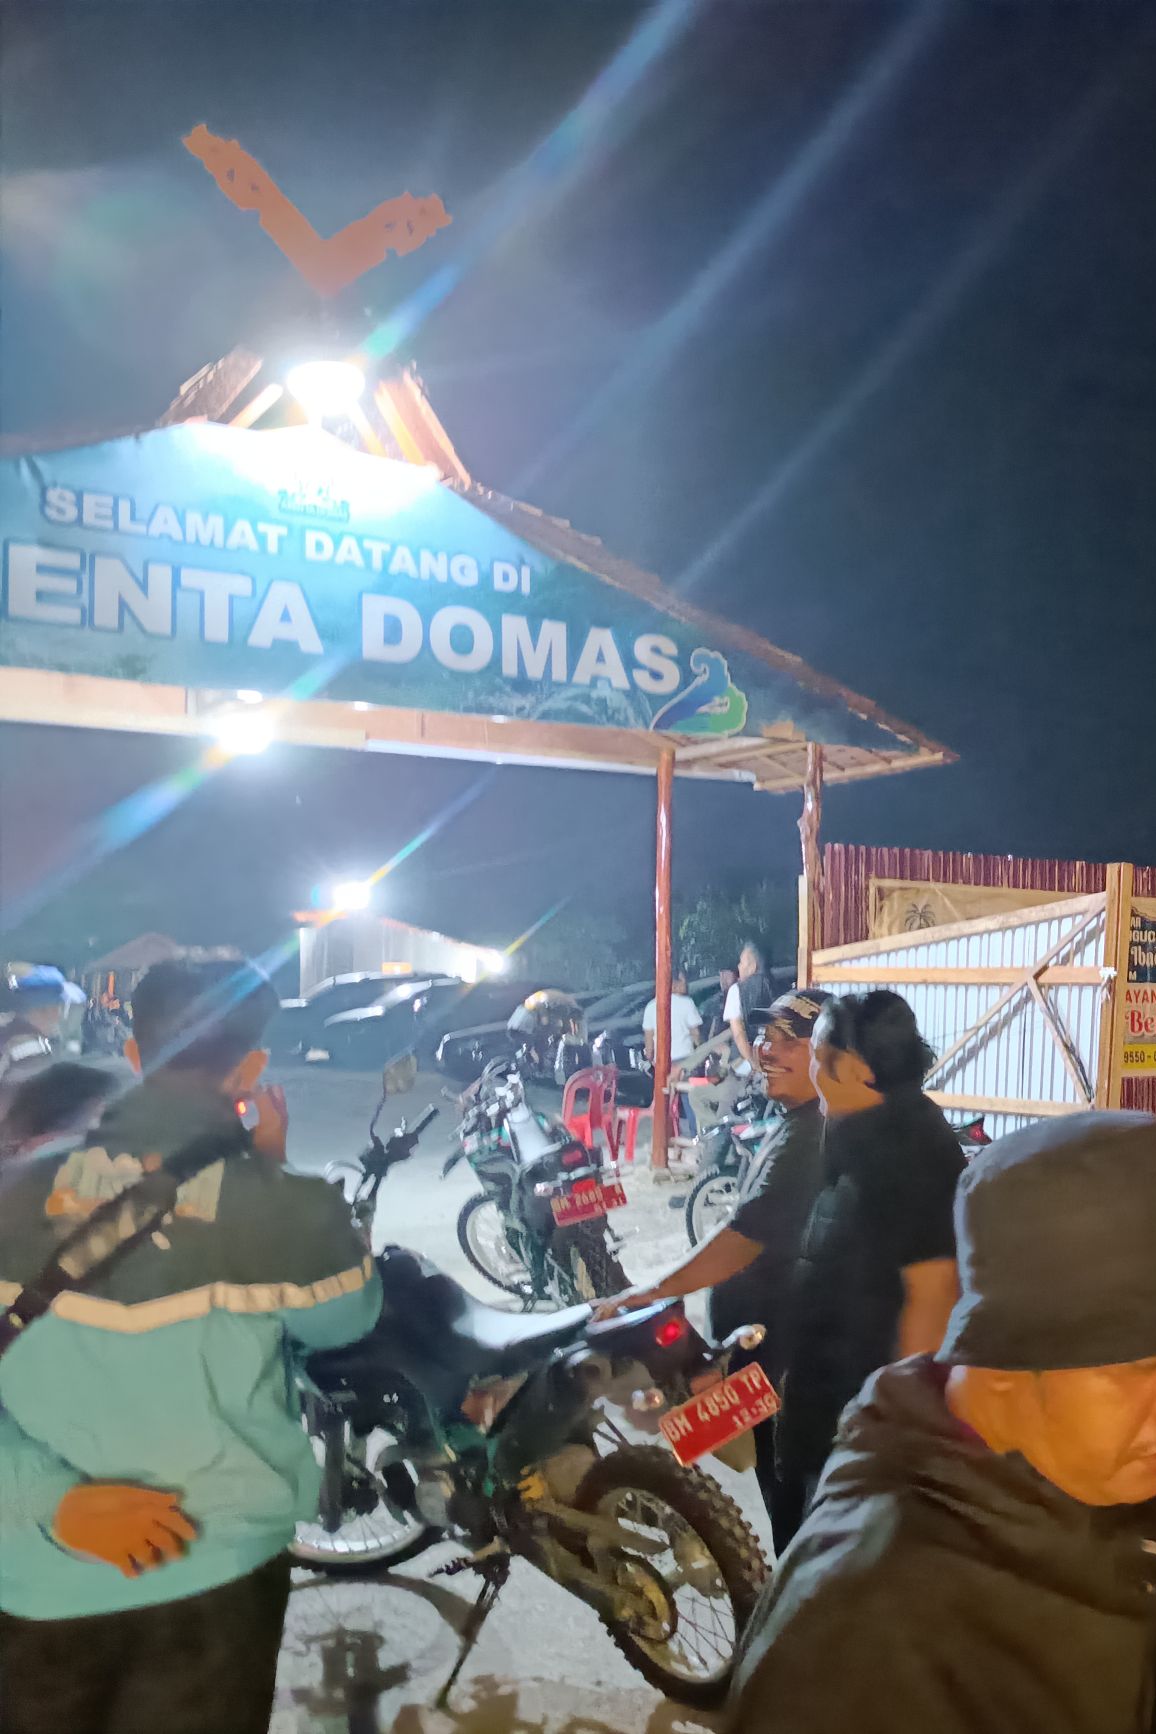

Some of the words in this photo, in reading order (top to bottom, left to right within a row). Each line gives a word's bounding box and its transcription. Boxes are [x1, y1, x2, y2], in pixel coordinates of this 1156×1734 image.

[44, 487, 288, 555] SELAMAT
[304, 530, 479, 587] DATANG
[6, 541, 325, 655] ENTA
[360, 591, 681, 695] DOMAS
